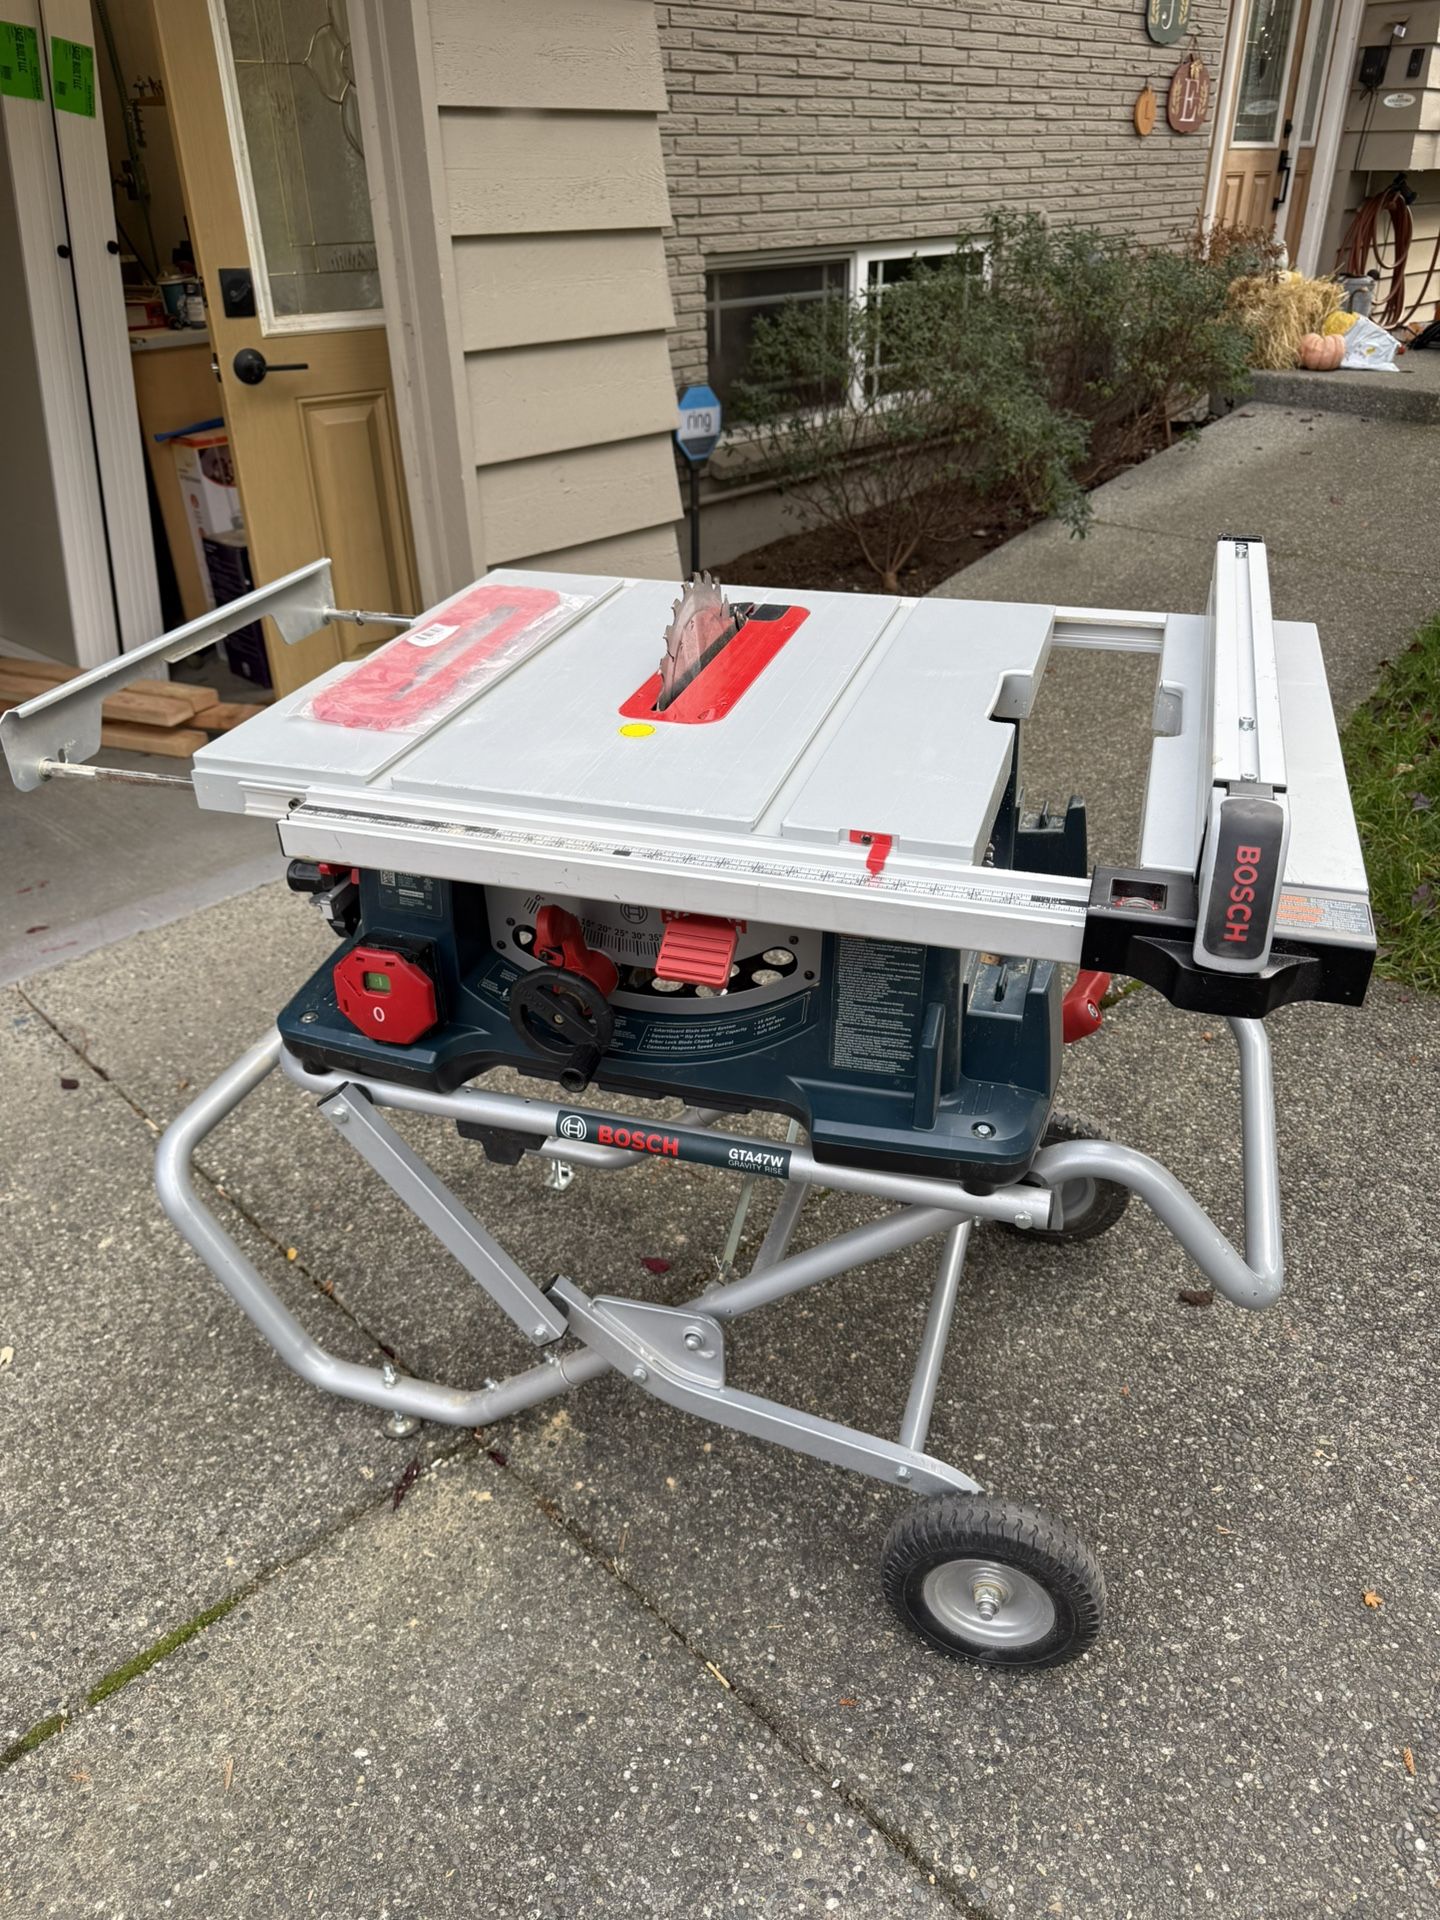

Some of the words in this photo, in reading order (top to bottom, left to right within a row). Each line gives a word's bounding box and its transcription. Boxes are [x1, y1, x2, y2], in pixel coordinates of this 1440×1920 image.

[1179, 78, 1200, 122] E
[687, 411, 712, 432] ring
[1223, 844, 1262, 944] BOSCH
[598, 924, 612, 932] 20°
[614, 928, 629, 937] 25°
[631, 931, 646, 940] 30°
[597, 1124, 680, 1157] BOSCH
[728, 1148, 784, 1168] GTA47W
[728, 1159, 763, 1173] GRAVITY
[765, 1165, 783, 1176] RISE
